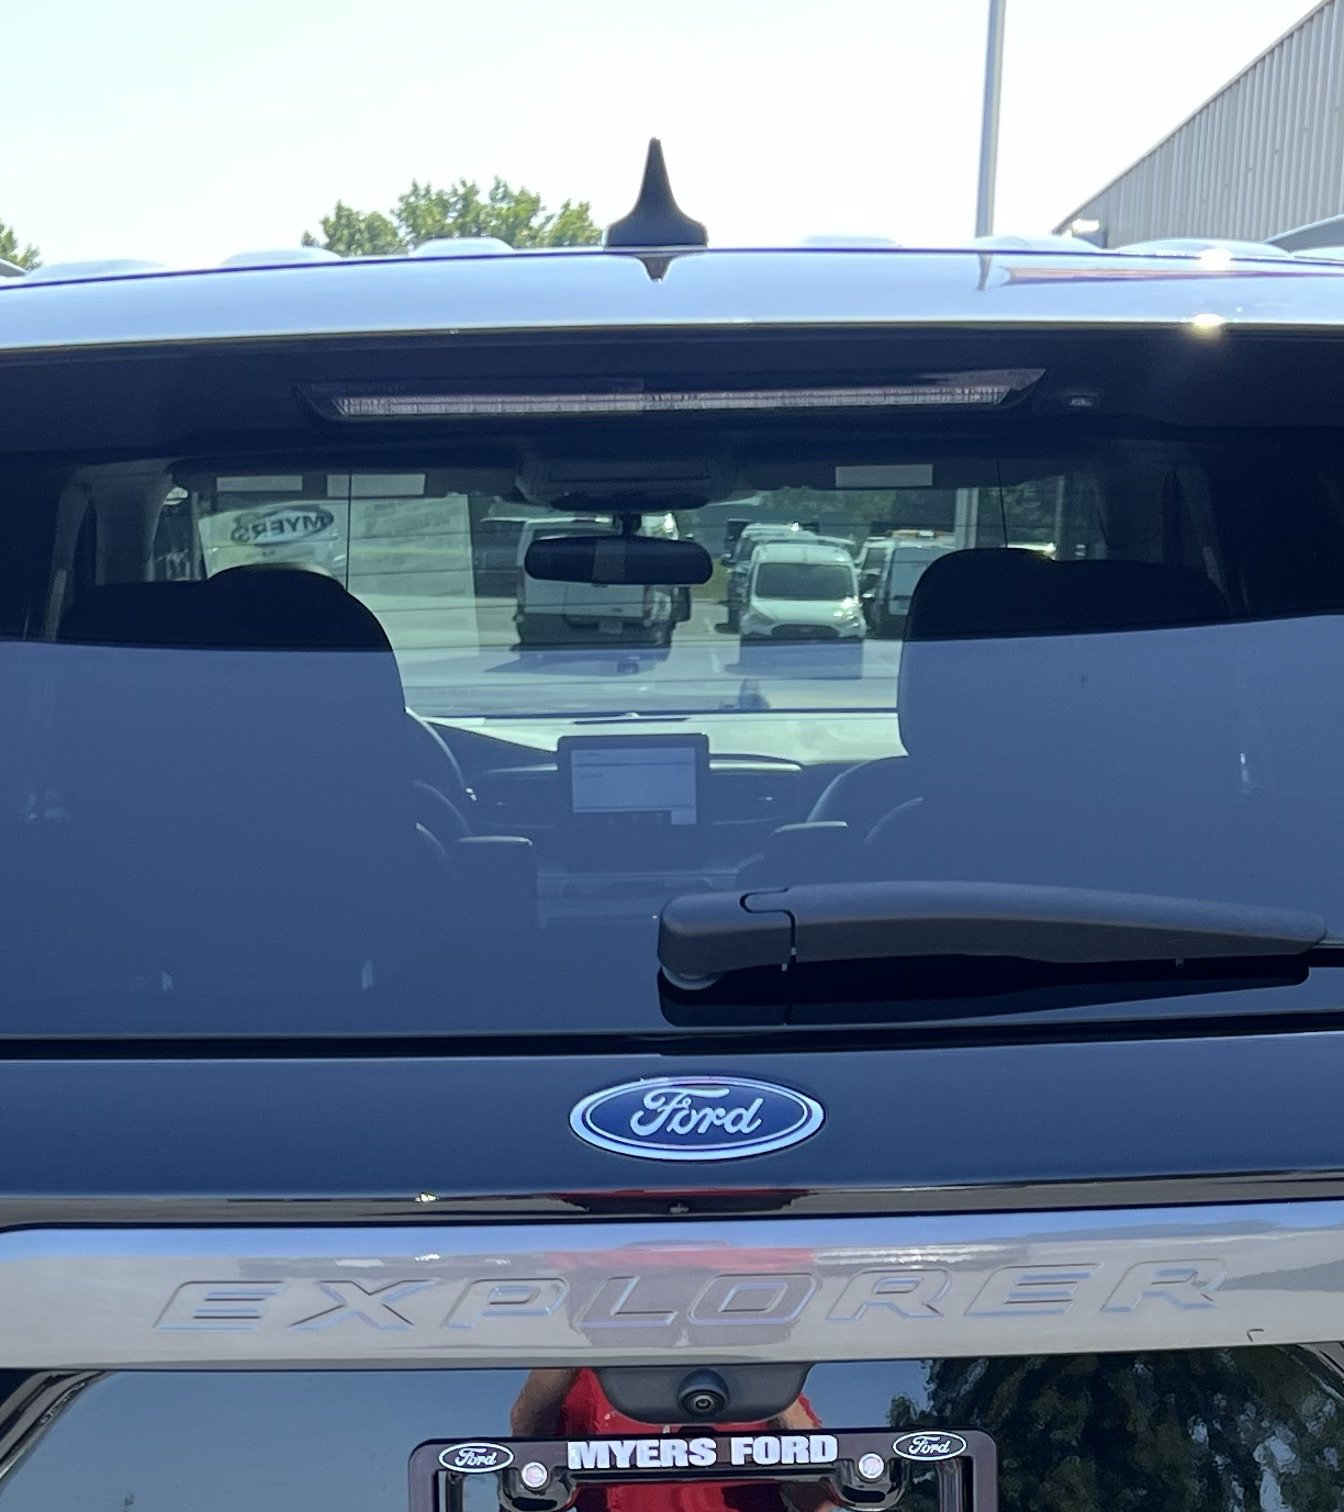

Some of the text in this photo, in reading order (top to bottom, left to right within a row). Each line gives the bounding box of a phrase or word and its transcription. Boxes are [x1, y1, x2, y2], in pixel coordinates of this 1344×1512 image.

[629, 1087, 764, 1137] Ford
[153, 1258, 1233, 1332] EXPLORER
[454, 1447, 498, 1467] Ford
[567, 1435, 838, 1470] MYERS FORD
[908, 1435, 952, 1455] Ford
